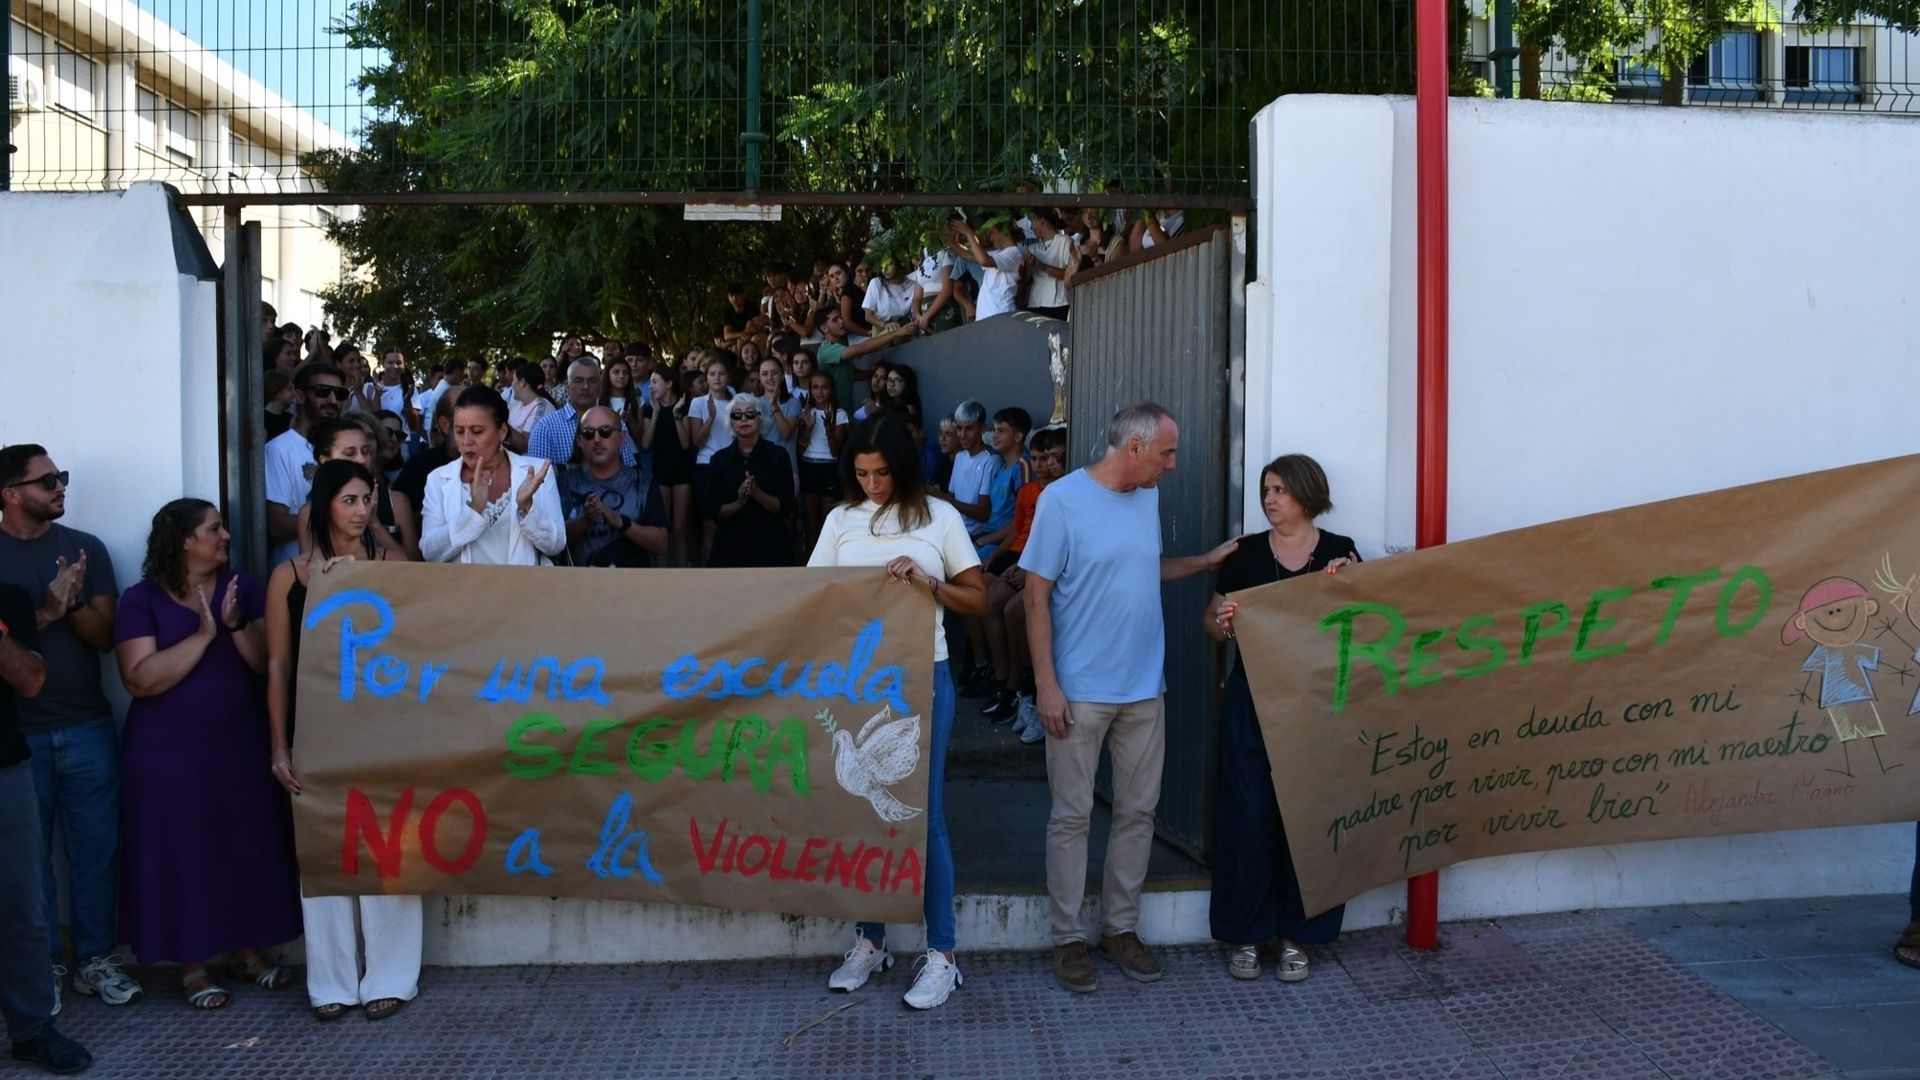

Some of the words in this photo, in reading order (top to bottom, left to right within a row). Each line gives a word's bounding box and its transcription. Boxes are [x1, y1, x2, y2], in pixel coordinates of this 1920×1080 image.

[304, 588, 449, 702] Por
[474, 653, 614, 705] una
[660, 617, 911, 713] escuela
[1316, 565, 1774, 713] RESPETO
[503, 711, 812, 796] SEGURA
[1467, 726, 1501, 749] en
[1517, 695, 1610, 739] deuda
[1623, 697, 1674, 724] con
[1690, 684, 1743, 713] mi
[340, 786, 488, 878] NO
[502, 827, 555, 877] a
[584, 791, 664, 883] la
[1327, 791, 1404, 853] padre
[1411, 779, 1457, 826] por
[1470, 765, 1539, 795] vivir,
[1546, 759, 1606, 796] pero
[1612, 751, 1660, 775] con
[1668, 740, 1711, 768] mi
[1398, 822, 1460, 873] por
[1482, 806, 1568, 835] vivir
[1683, 778, 1777, 827] Alejandro
[1791, 771, 1861, 816] Magno
